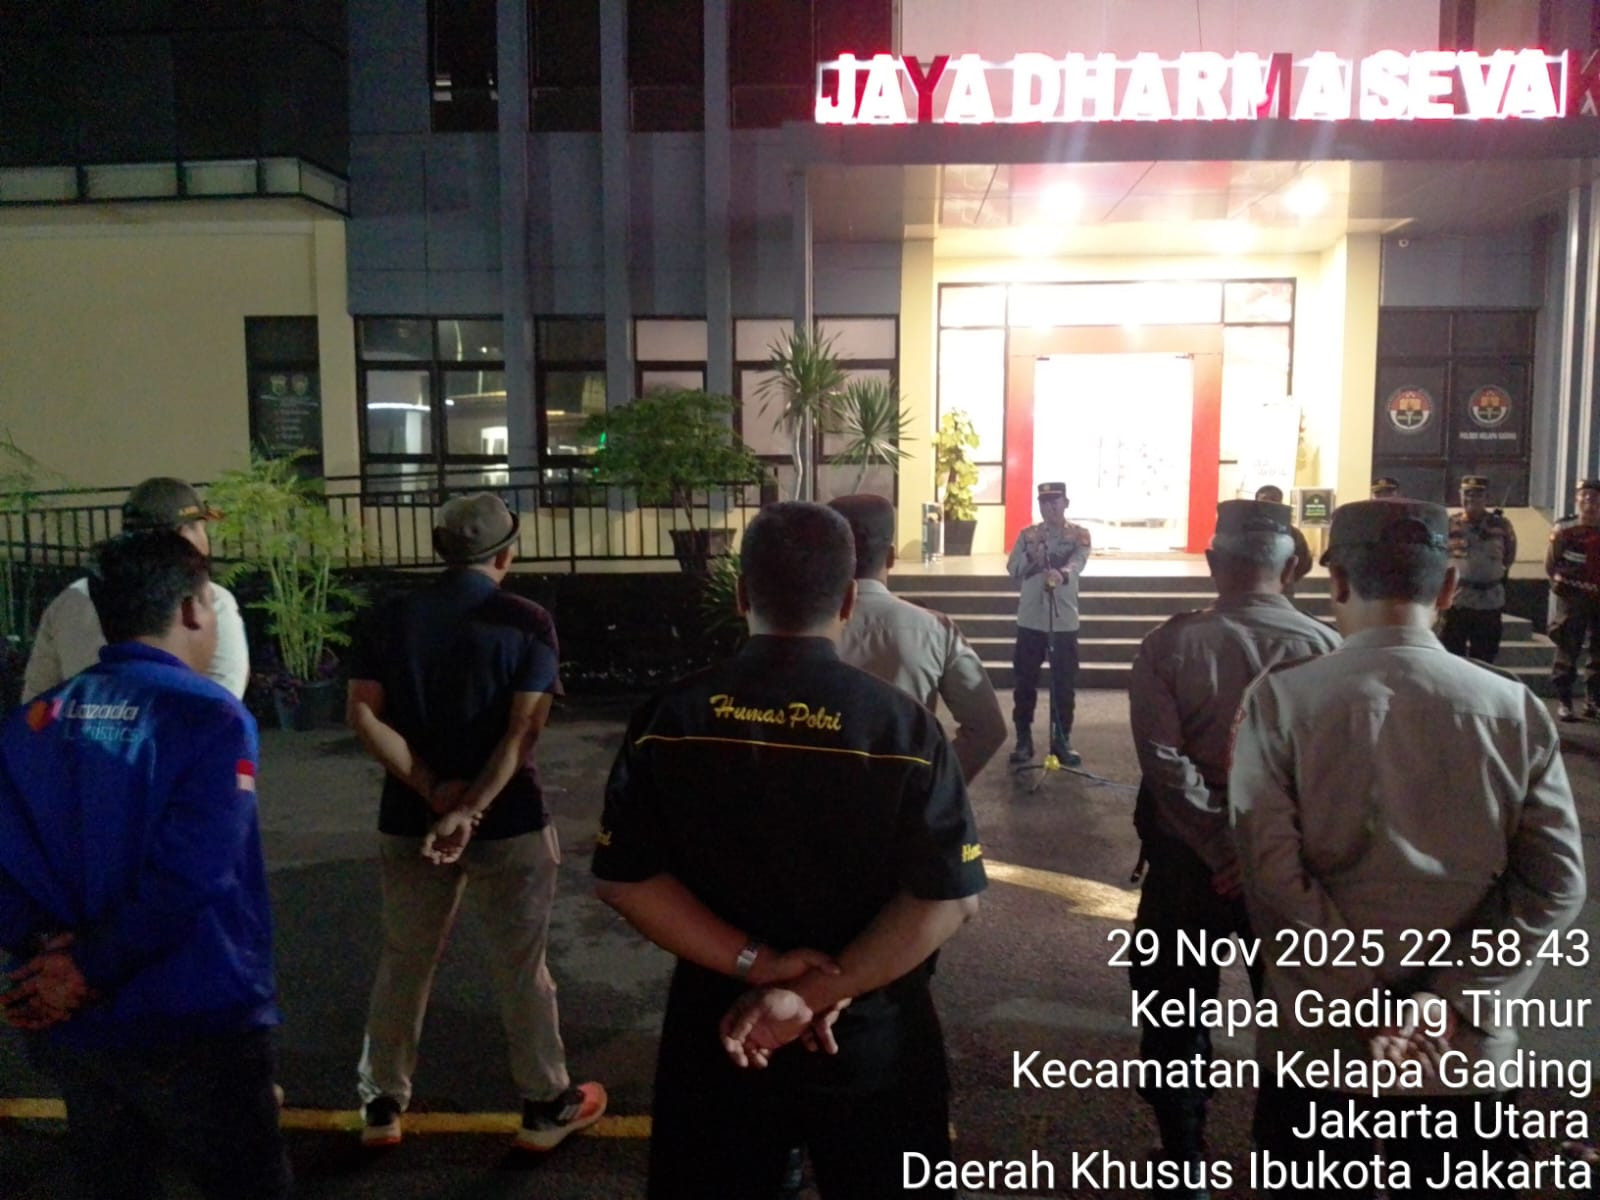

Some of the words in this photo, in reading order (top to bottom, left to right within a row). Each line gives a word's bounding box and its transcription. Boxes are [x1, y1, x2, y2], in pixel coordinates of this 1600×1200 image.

[815, 52, 995, 124] JAYA
[1009, 50, 1351, 122] DHARMA
[1360, 48, 1559, 120] SEVA
[65, 698, 140, 721] Lazada
[709, 693, 785, 725] Humas
